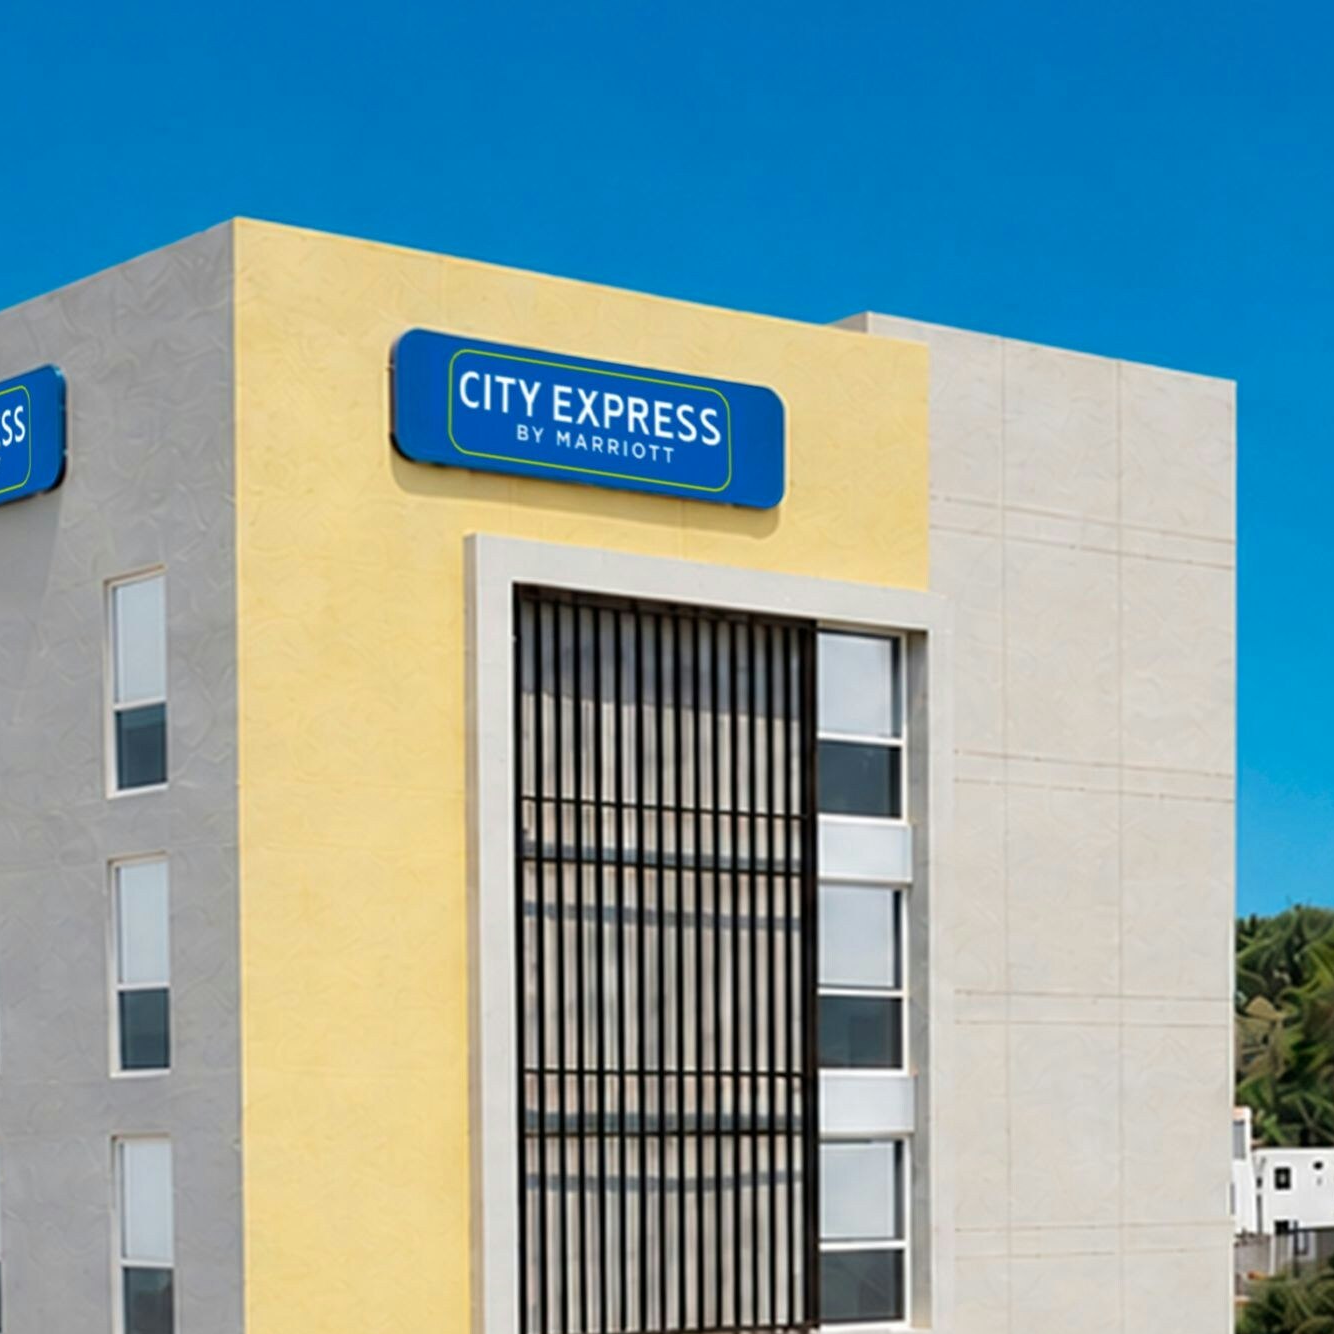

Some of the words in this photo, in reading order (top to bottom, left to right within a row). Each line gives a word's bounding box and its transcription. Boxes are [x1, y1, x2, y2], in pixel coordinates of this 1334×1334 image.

[459, 371, 541, 418] CITY
[552, 385, 721, 446] EXPRESS
[517, 424, 544, 443] BY
[556, 431, 675, 463] MARRIOTT
